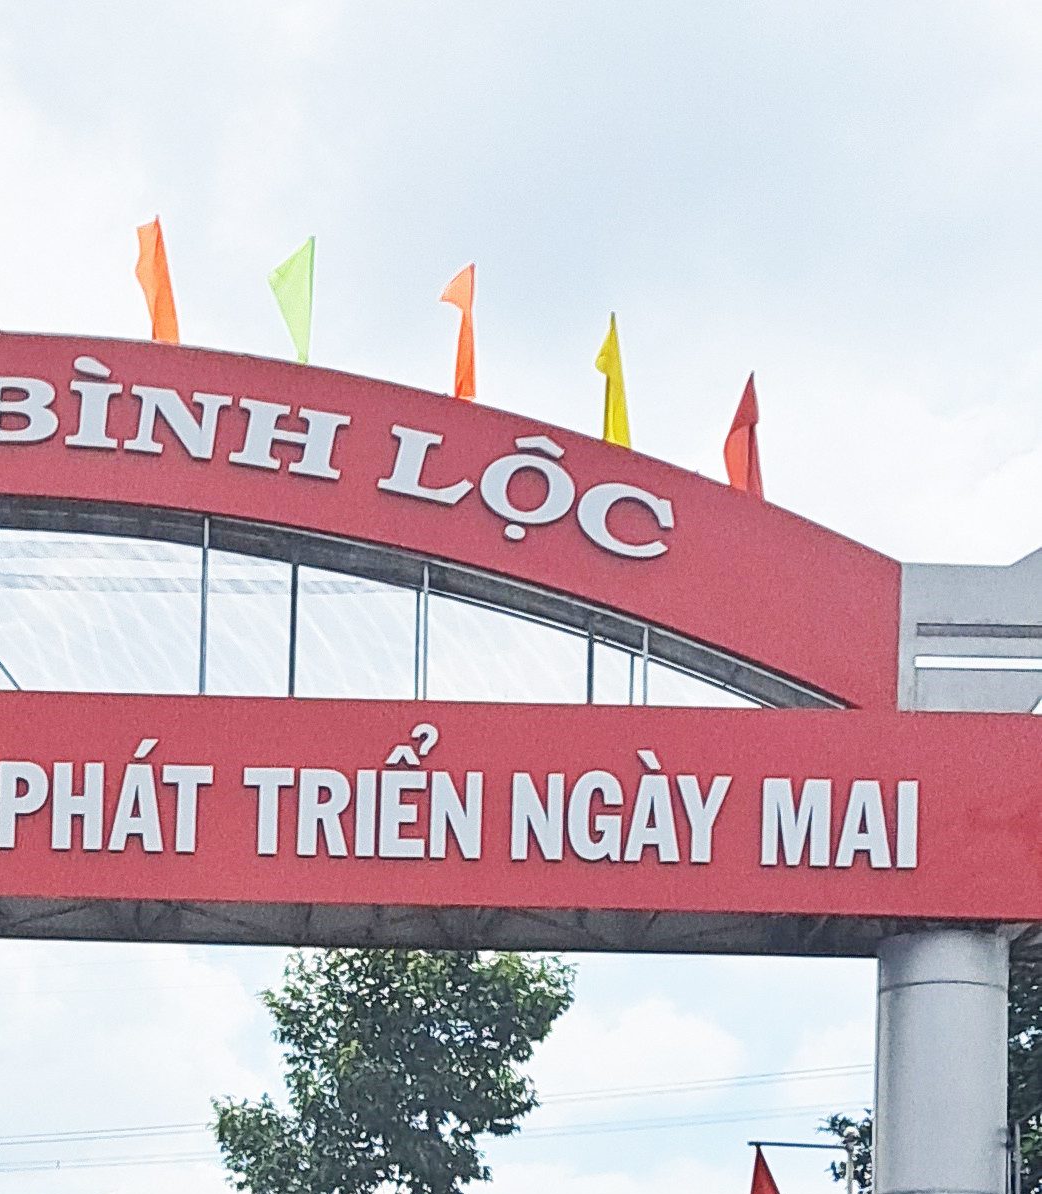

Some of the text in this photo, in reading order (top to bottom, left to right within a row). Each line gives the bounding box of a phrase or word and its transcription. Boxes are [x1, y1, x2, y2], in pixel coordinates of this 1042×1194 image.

[377, 423, 675, 558] LỘC
[243, 723, 484, 859] TRIỂN
[510, 749, 733, 863] NGÀY
[760, 777, 919, 868] MAI
